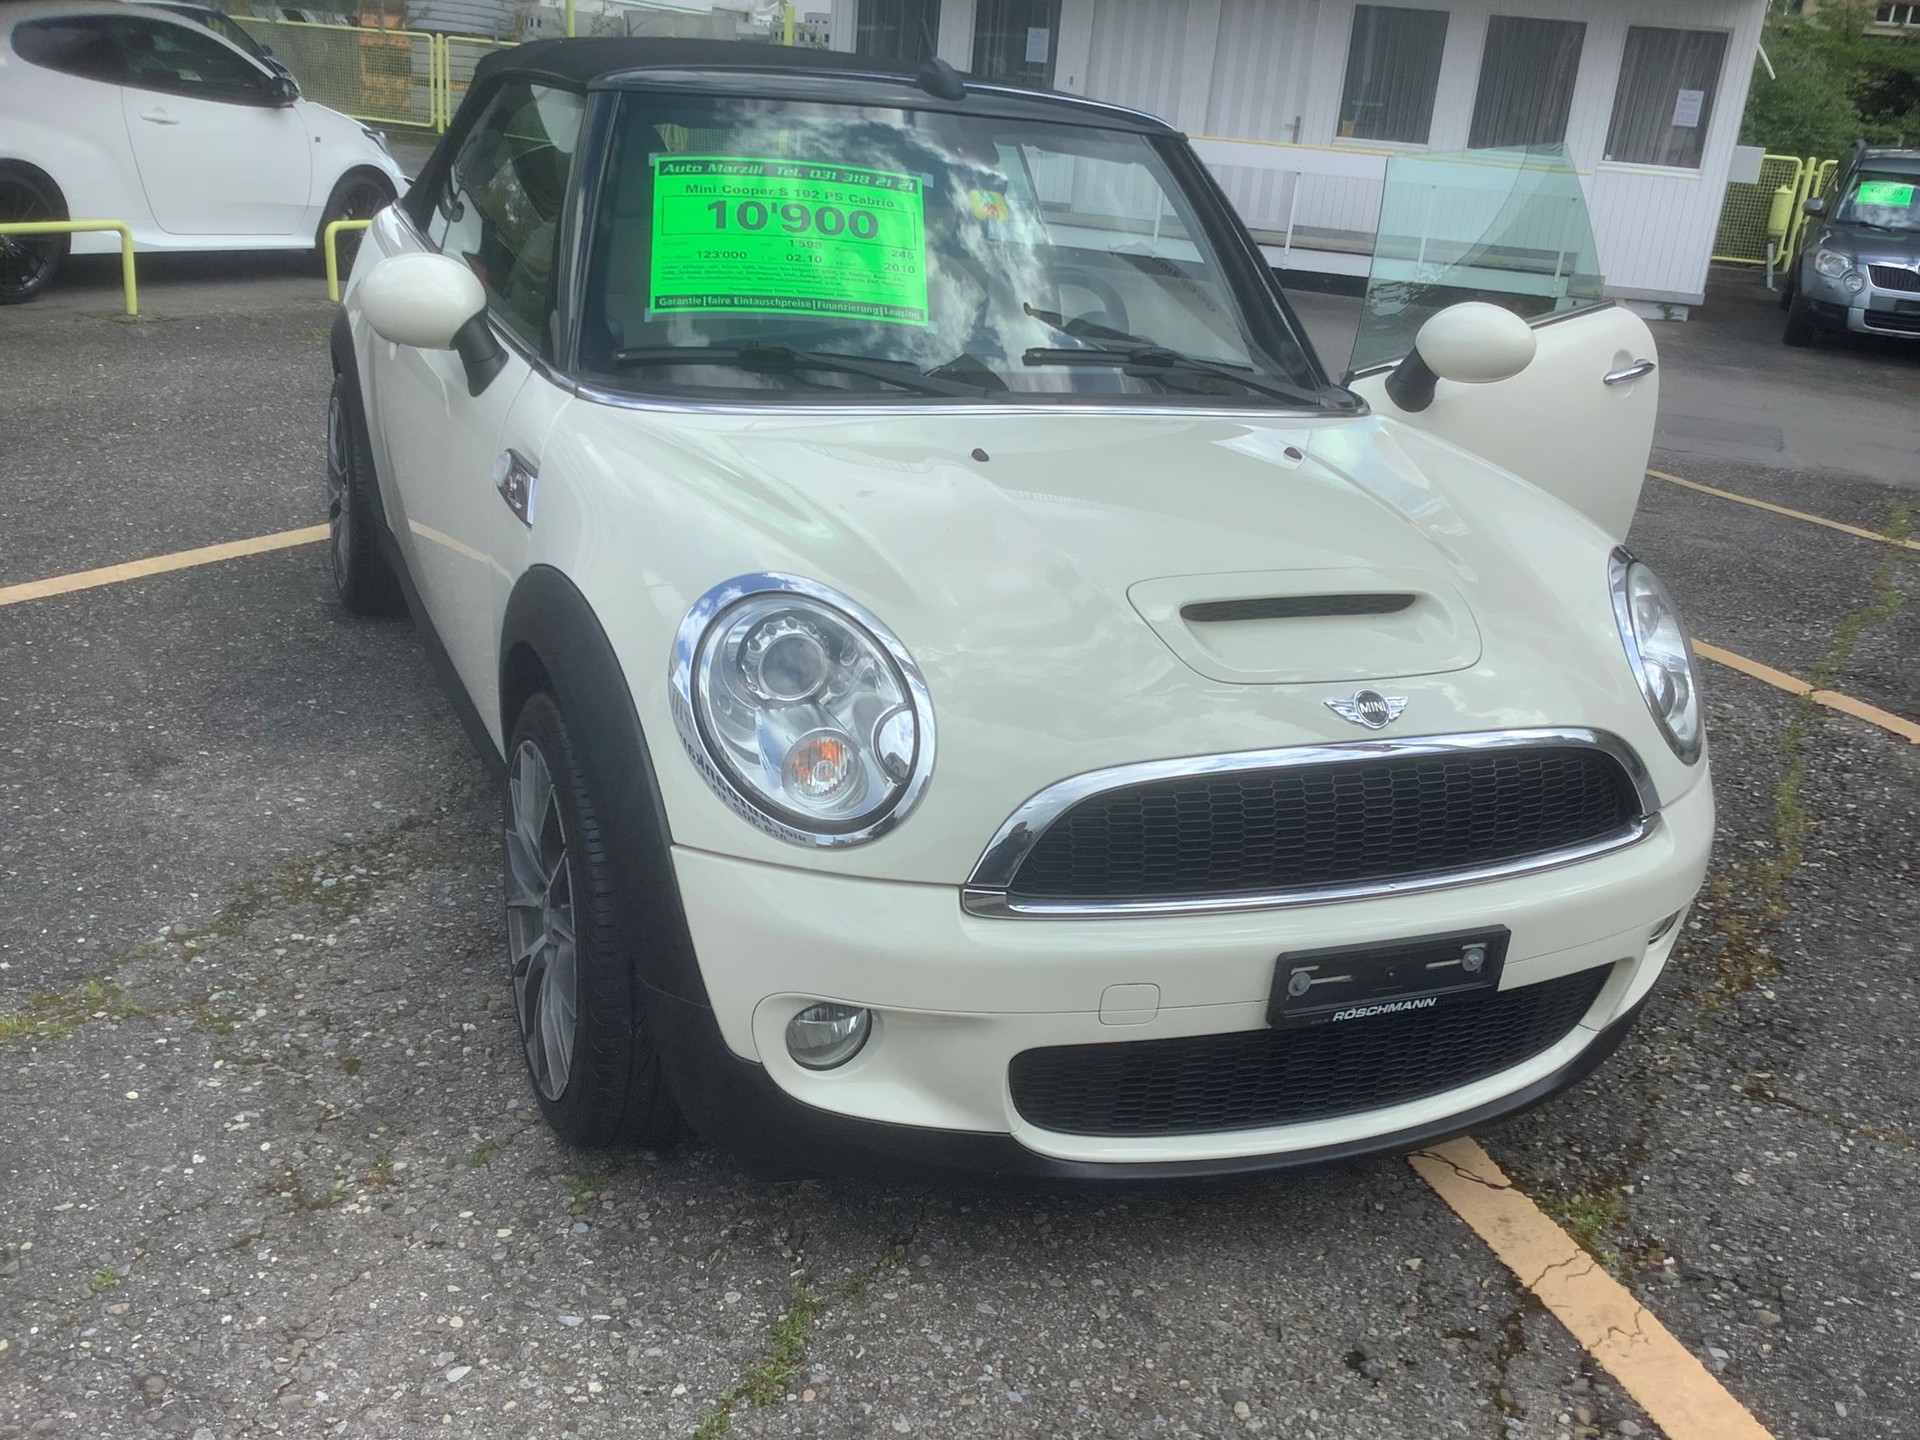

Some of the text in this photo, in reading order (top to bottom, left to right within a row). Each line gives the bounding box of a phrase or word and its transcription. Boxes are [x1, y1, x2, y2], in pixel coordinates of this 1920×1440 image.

[663, 163, 703, 174] Auto
[776, 166, 803, 178] Tel.
[809, 169, 838, 180] 031
[843, 172, 871, 185] 318
[875, 177, 892, 187] 21
[898, 181, 914, 191] 21
[685, 184, 895, 208] Mini Cooper S 192 PS Cabrio
[707, 200, 879, 240] 10'900
[697, 250, 748, 260] 123'000
[786, 253, 822, 264] 02.10
[884, 262, 916, 274] 2010
[659, 295, 920, 320] Garantie faire Eintauschpreise Finanzierung Leasing
[1359, 701, 1388, 714] MINI
[1332, 997, 1438, 1022] RÖSCHMANN
